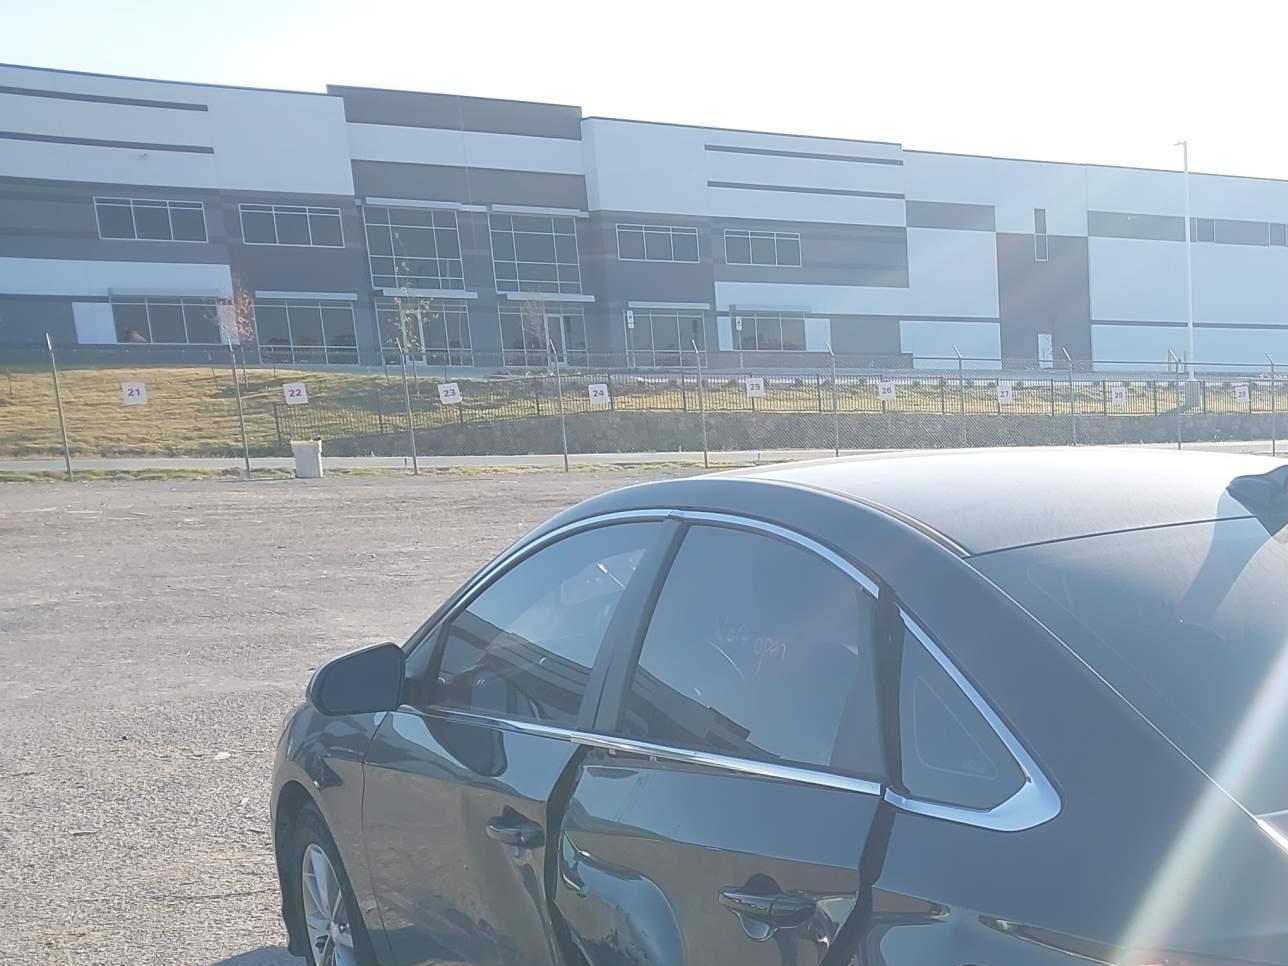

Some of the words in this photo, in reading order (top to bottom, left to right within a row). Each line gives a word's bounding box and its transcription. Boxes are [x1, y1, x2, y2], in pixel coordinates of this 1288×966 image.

[750, 383, 761, 391] 25
[881, 386, 892, 394] 26
[127, 388, 141, 397] 21
[289, 387, 302, 396] 22
[443, 388, 456, 397] 23
[592, 389, 604, 397] 24
[1000, 390, 1009, 398] 27
